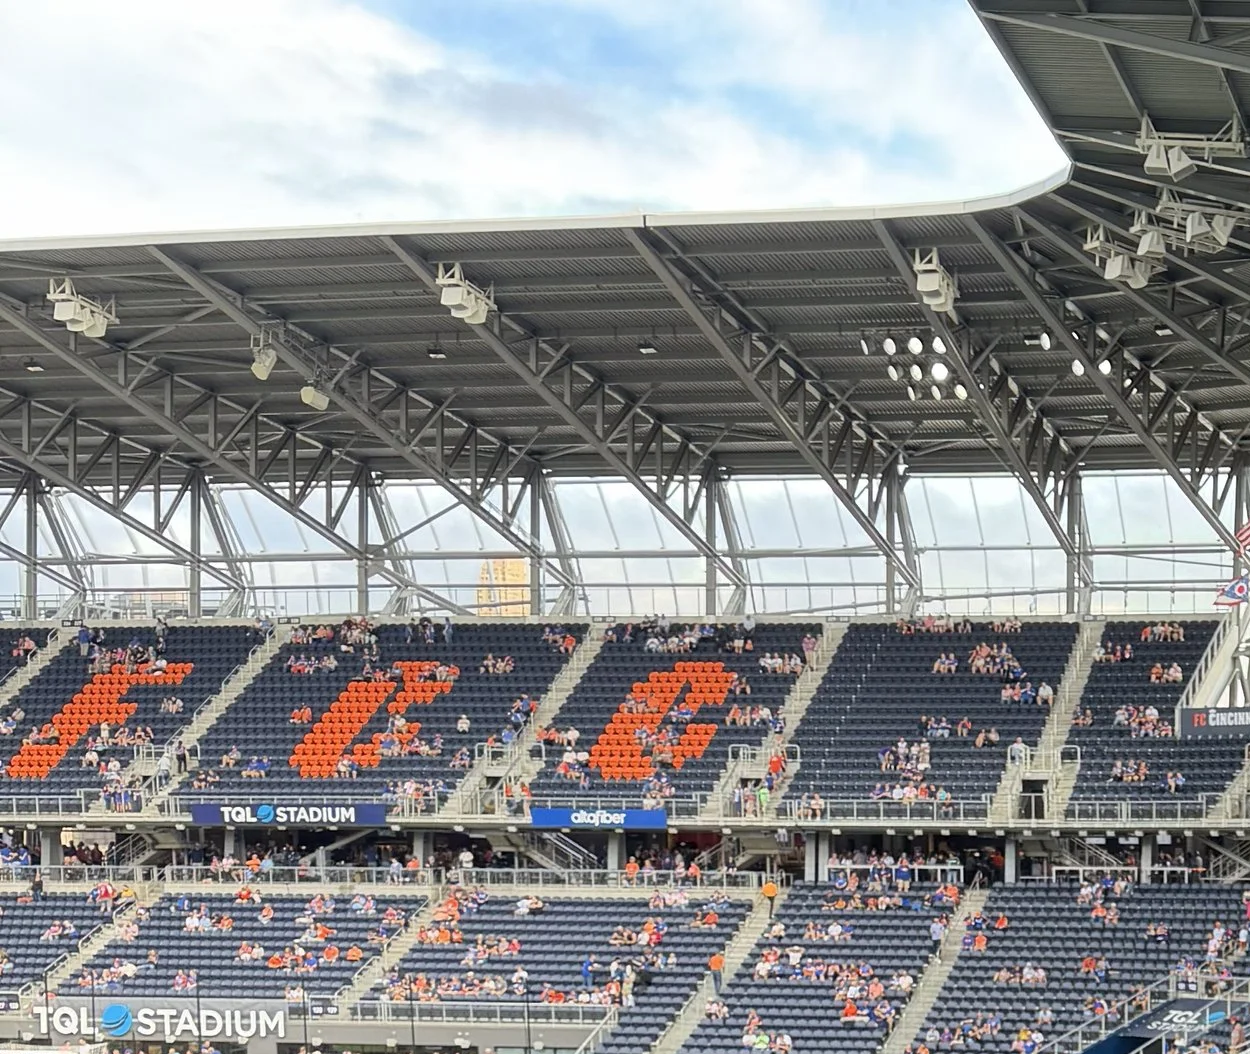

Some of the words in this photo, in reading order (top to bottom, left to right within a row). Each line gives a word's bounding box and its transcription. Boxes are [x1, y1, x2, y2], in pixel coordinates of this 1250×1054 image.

[1192, 713, 1207, 727] FC
[220, 806, 257, 823] TQL
[276, 806, 355, 823] STADIUM
[33, 1006, 98, 1036] TQL
[137, 1008, 285, 1038] STADIUM
